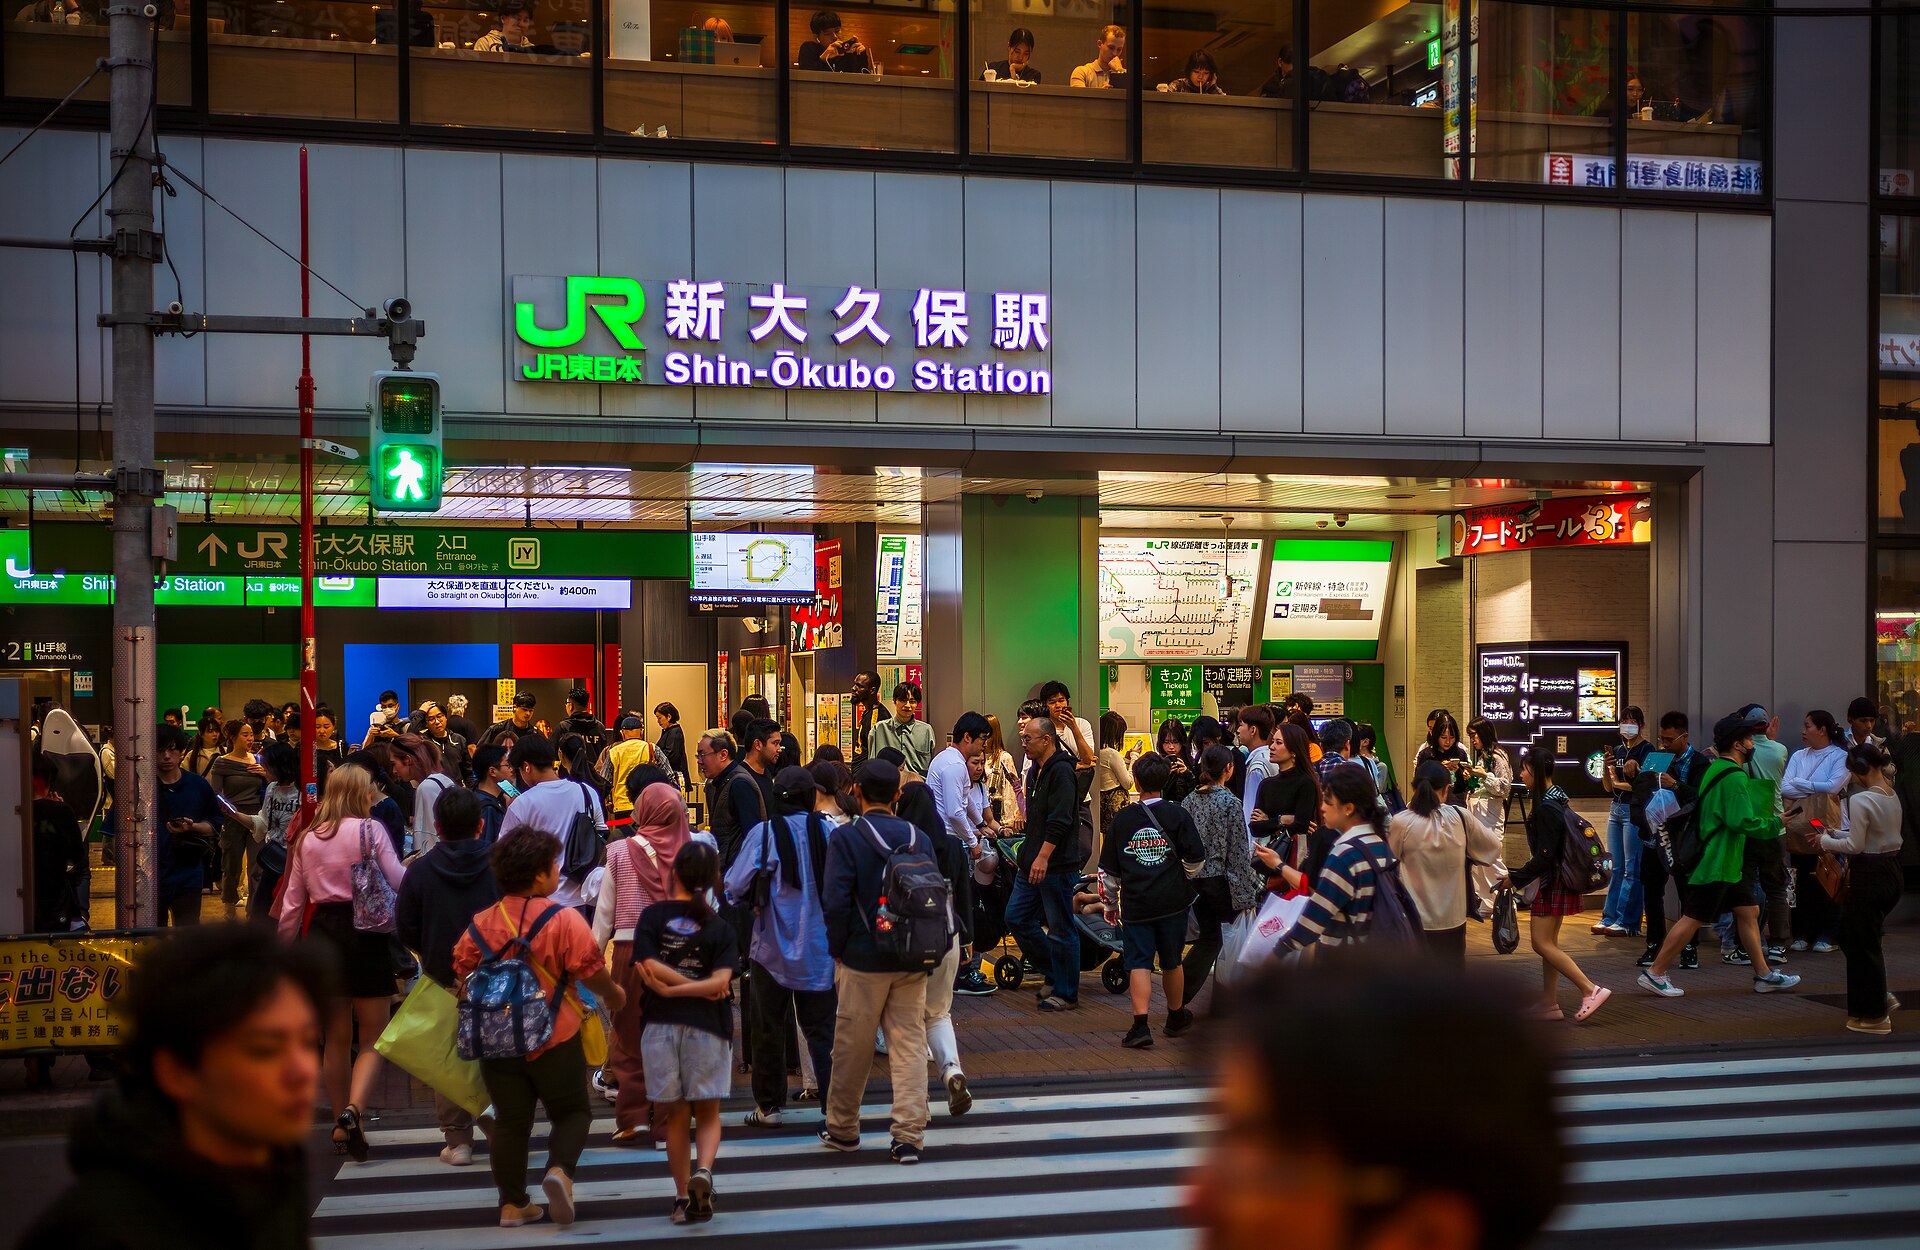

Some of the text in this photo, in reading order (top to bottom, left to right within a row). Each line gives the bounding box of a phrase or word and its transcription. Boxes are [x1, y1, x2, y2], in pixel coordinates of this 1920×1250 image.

[516, 277, 646, 350] JR
[665, 280, 1050, 352] 新大久保駅
[522, 353, 643, 383] JR東日本
[664, 350, 1052, 395] Shin-Ōkubo Station
[1470, 517, 1583, 548] フードホール
[237, 532, 288, 559] JR
[436, 535, 467, 550] 入口
[436, 551, 477, 561] Entrance
[515, 547, 533, 560] JY
[381, 559, 428, 572] Station
[437, 562, 452, 571] 入口
[14, 580, 58, 590] JR東日本
[174, 577, 225, 592] Station
[246, 583, 263, 592] 入口
[559, 586, 597, 596] 約400m
[427, 591, 439, 599] Go
[440, 591, 468, 600] straight
[522, 591, 540, 599] Ave.
[1291, 603, 1318, 613] 定期券
[7, 641, 21, 660] 2
[34, 642, 67, 653] 山手線
[1160, 668, 1193, 681] きっぷ
[1204, 667, 1252, 682] きっぷ 定期券
[1520, 672, 1540, 693] 4F
[1520, 699, 1540, 720] 3F
[1128, 838, 1168, 849] VISION
[21, 951, 49, 964] the
